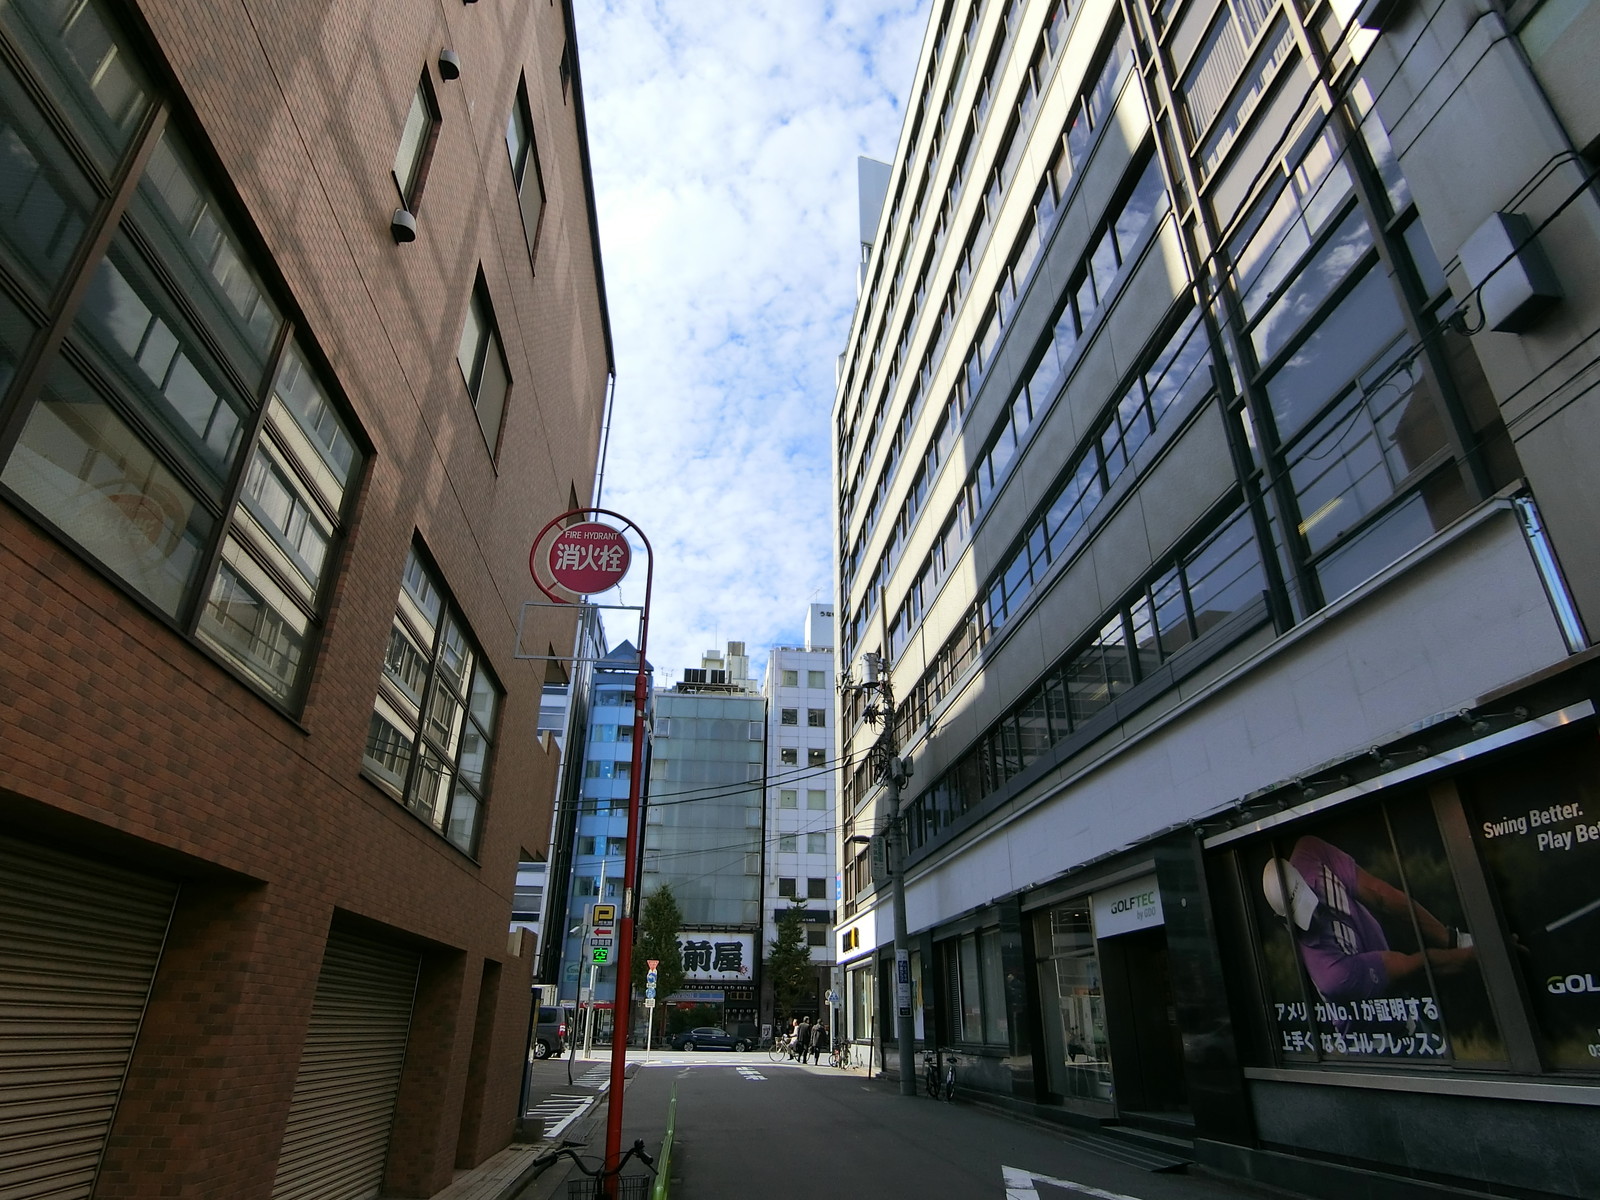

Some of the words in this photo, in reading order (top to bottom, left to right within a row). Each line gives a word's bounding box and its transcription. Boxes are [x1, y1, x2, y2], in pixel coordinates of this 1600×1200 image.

[565, 531, 582, 540] FIRE
[584, 532, 619, 541] HYDRANT
[555, 543, 625, 572] 消火栓
[1483, 816, 1527, 839] Swing
[1529, 802, 1584, 828] Better.
[1537, 830, 1571, 851] Play
[1110, 891, 1155, 914] GOLFTEC
[1137, 910, 1143, 921] by
[592, 947, 609, 963] 空
